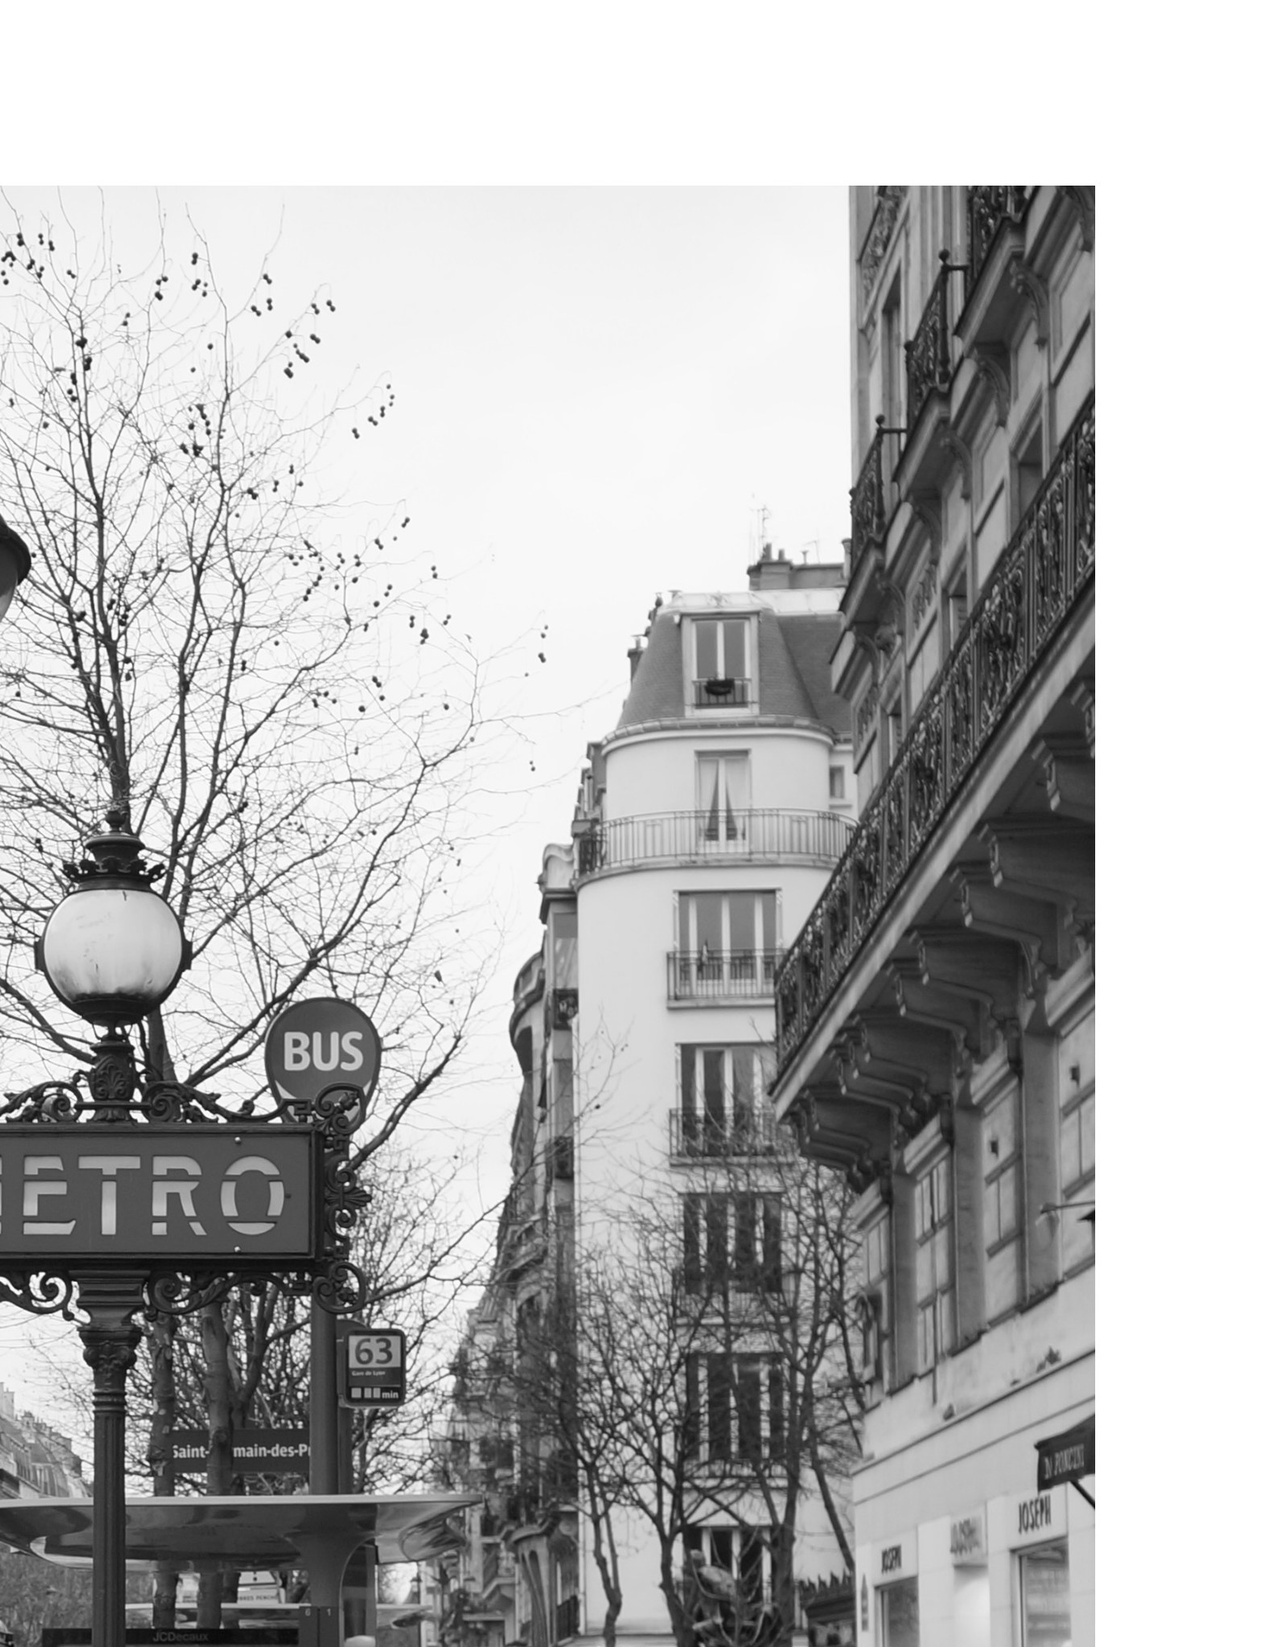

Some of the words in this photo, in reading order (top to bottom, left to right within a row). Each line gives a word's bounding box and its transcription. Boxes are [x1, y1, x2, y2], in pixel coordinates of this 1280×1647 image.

[283, 1031, 363, 1071] BUS
[355, 1337, 393, 1365] 63
[381, 1390, 399, 1399] min
[1018, 1494, 1052, 1535] JOSEPH
[152, 1631, 209, 1643] JCDecaux
